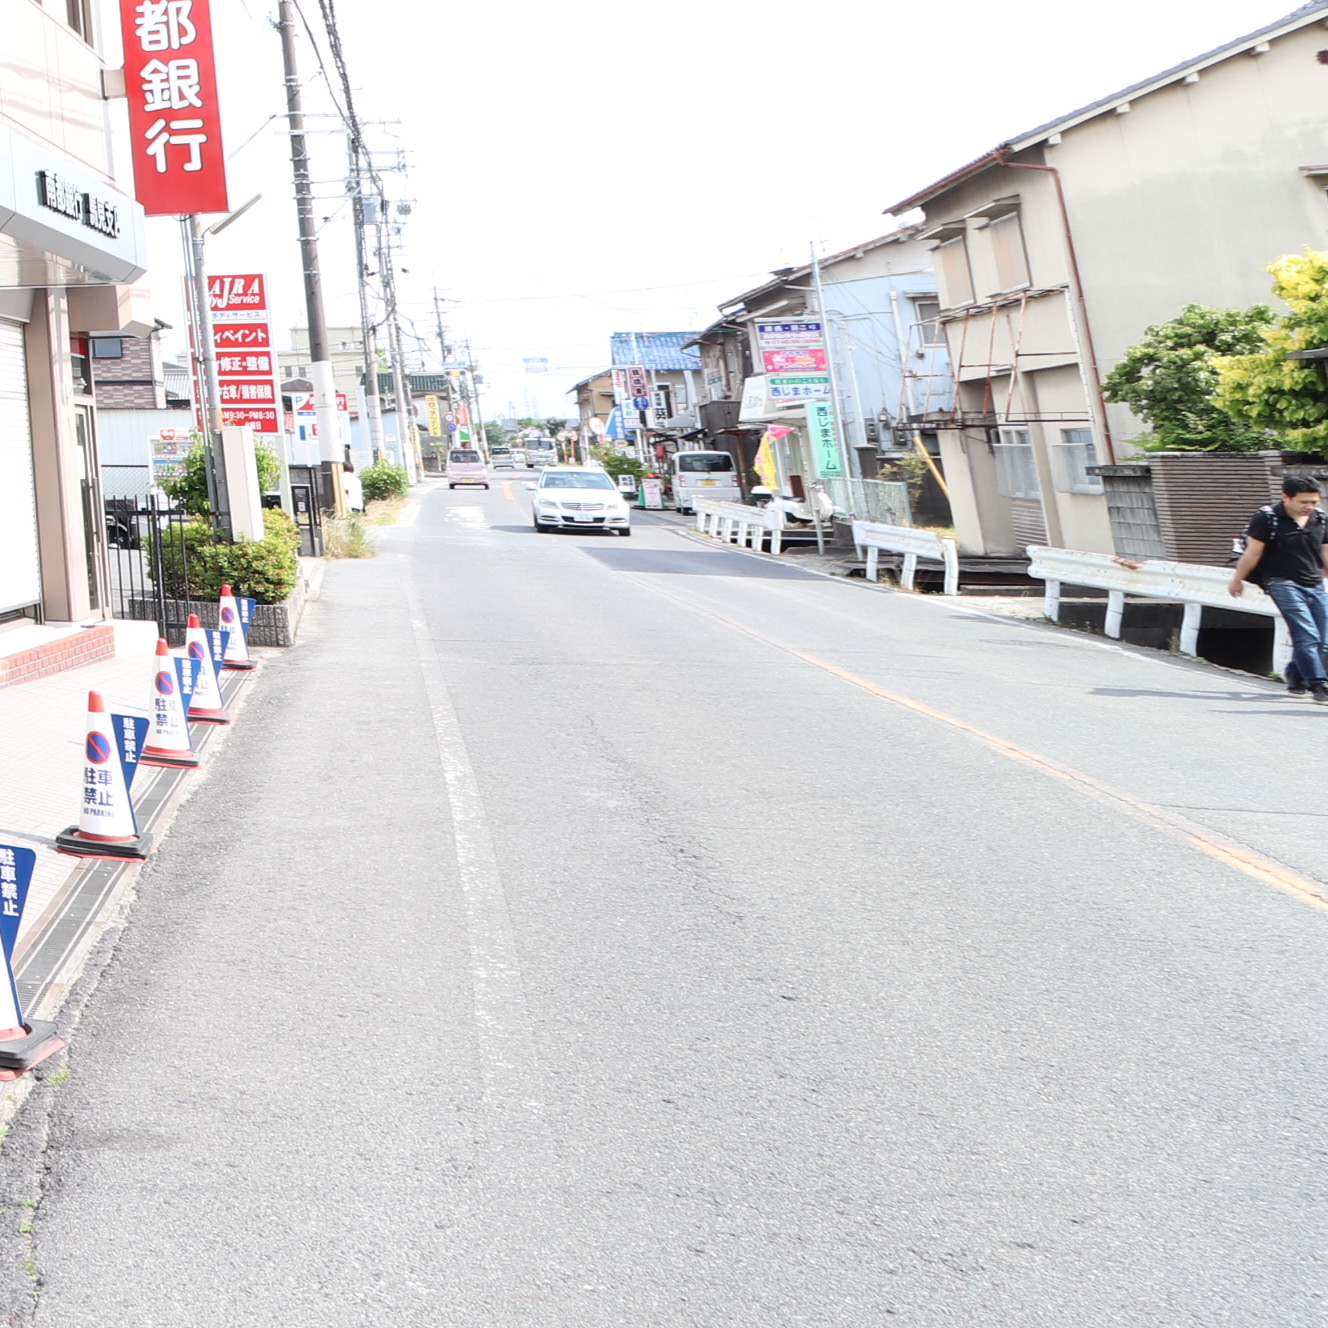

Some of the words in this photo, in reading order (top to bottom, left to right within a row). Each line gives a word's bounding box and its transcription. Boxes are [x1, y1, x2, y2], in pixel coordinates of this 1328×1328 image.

[228, 293, 261, 305] Service
[214, 328, 267, 344] ィペイント
[217, 355, 270, 372] 修正・整備
[219, 384, 273, 400] 古車/損害保険
[770, 386, 831, 397] 西じまホーム
[816, 406, 837, 470] 西じまホーム
[123, 717, 137, 763] 駐車禁止
[84, 767, 112, 786] 駐車
[84, 787, 114, 807] 禁止
